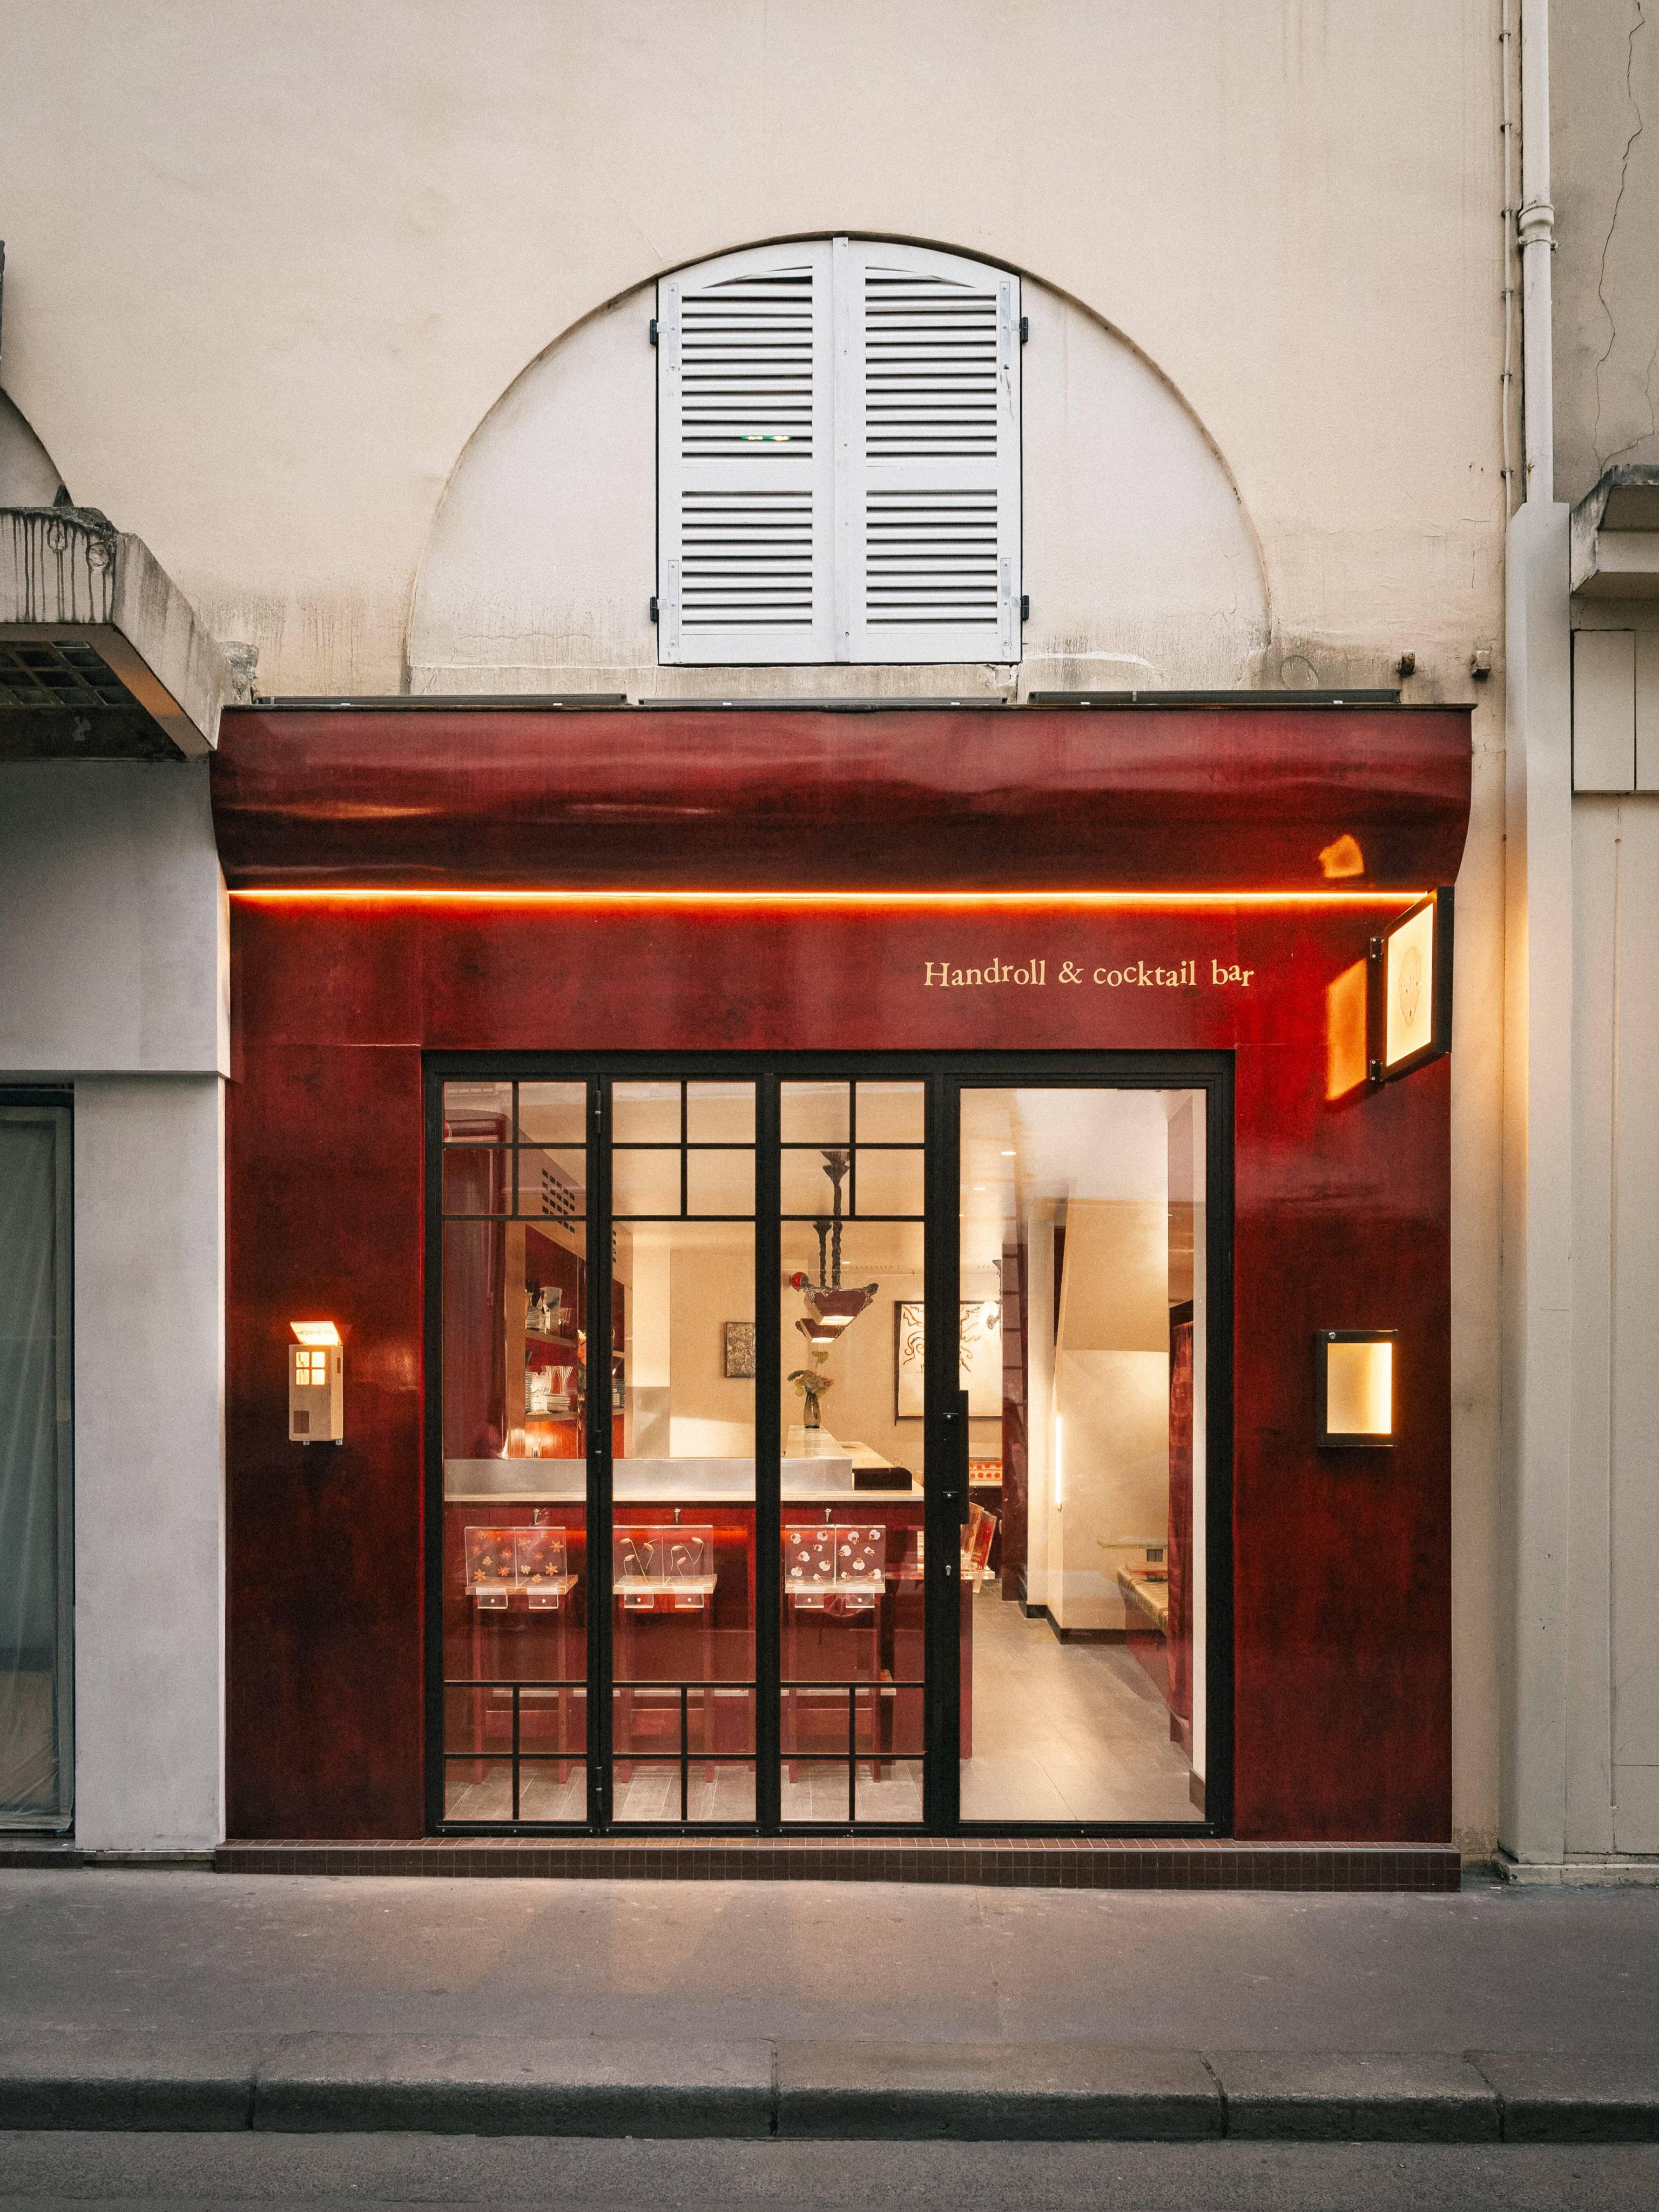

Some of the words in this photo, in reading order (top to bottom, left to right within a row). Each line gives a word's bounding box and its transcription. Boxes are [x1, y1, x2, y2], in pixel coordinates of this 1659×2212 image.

[924, 958, 1046, 986] Handroll
[1058, 962, 1083, 984] &
[1094, 960, 1197, 986] cocktail
[1211, 959, 1254, 986] bar
